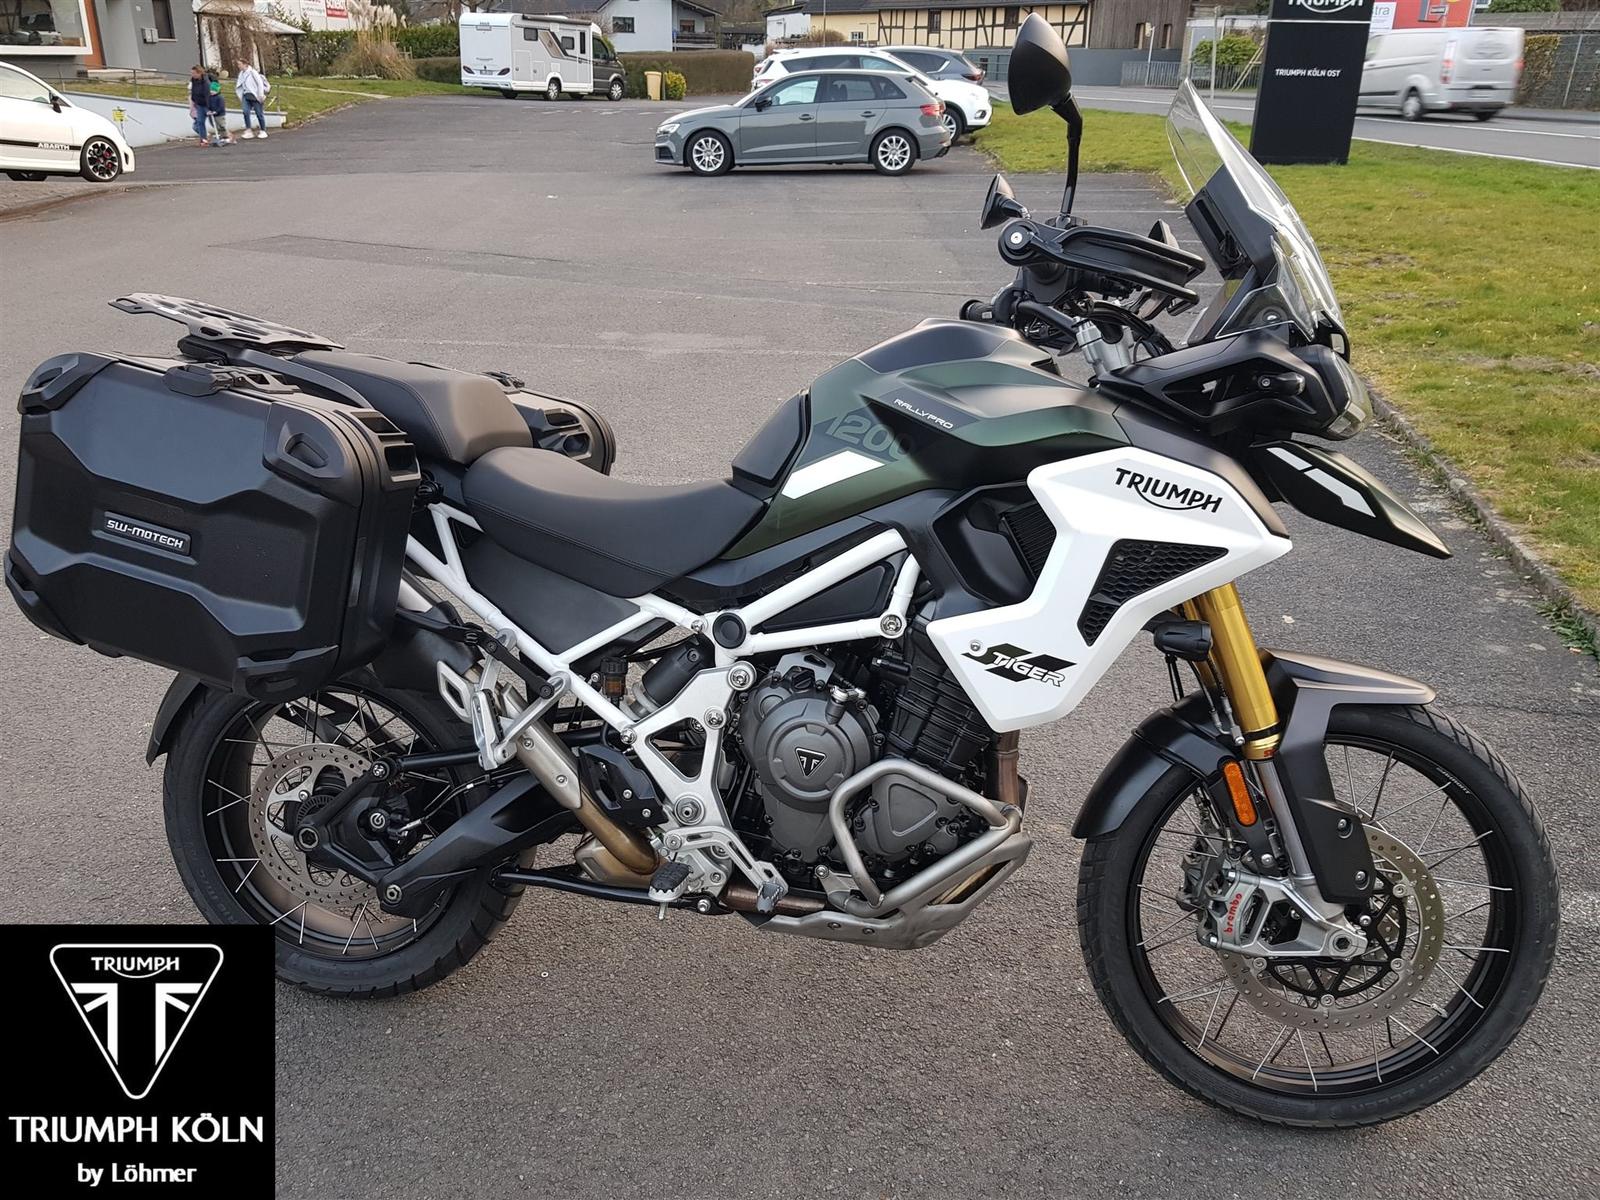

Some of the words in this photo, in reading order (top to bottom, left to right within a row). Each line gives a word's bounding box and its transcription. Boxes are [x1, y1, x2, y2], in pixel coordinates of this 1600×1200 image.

[1275, 68, 1306, 77] TRIUMPH
[1307, 67, 1326, 77] KÖLN
[1327, 69, 1341, 77] OST
[37, 142, 70, 151] ABARTH
[1115, 467, 1223, 513] TRIUMPH
[106, 519, 184, 549] SW-MOTECH
[992, 651, 1066, 687] TIGER
[1223, 893, 1243, 933] brembo
